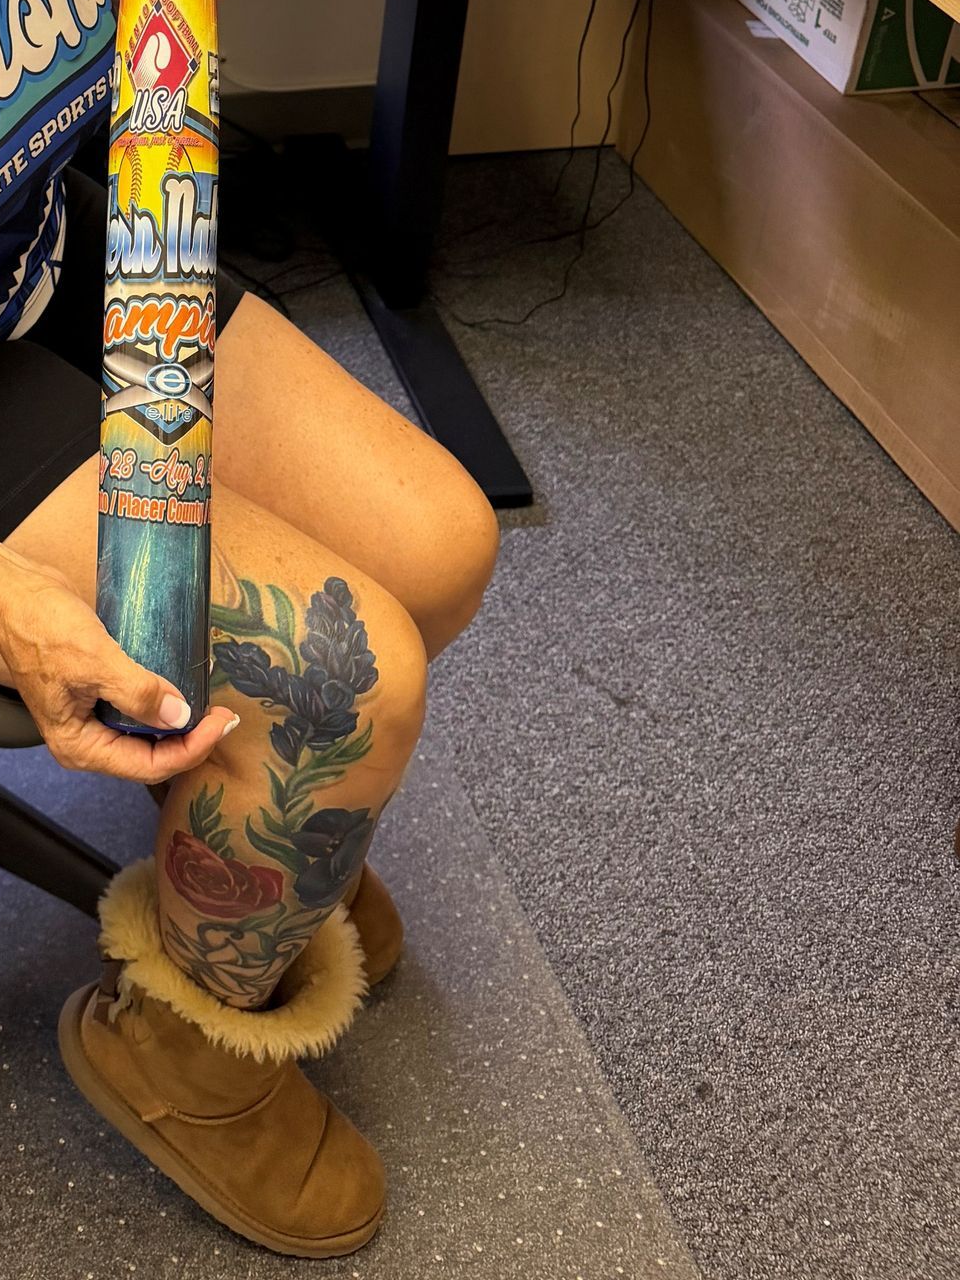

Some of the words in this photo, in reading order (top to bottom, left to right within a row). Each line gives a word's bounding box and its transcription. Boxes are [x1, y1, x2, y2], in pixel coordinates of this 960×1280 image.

[814, 8, 822, 29] 1
[28, 76, 107, 166] SPORTS
[128, 86, 188, 134] USA
[145, 403, 193, 422] elite
[109, 448, 137, 479] 28
[118, 491, 167, 521] Placer
[166, 495, 204, 527] County
